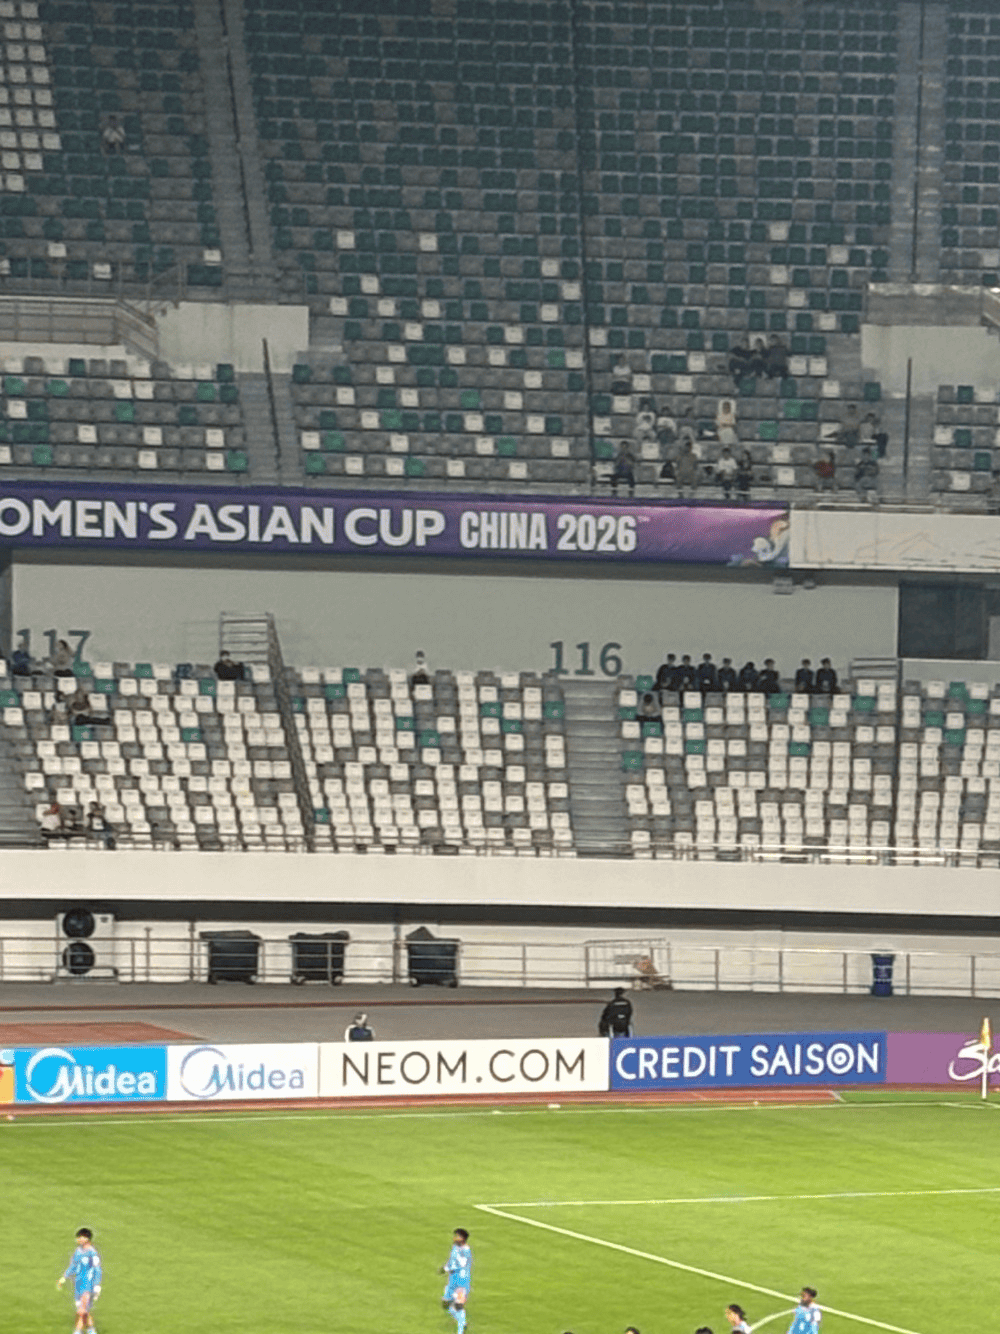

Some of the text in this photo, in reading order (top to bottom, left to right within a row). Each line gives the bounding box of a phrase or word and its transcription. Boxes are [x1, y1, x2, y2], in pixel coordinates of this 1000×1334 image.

[184, 503, 334, 544] ASIAN
[344, 507, 446, 547] CUP
[459, 510, 549, 550] CHINA
[556, 513, 637, 552] 2026
[548, 640, 623, 677] 116
[341, 1047, 587, 1087] NEOM.COM
[615, 1042, 879, 1080] CREDIT SAISON
